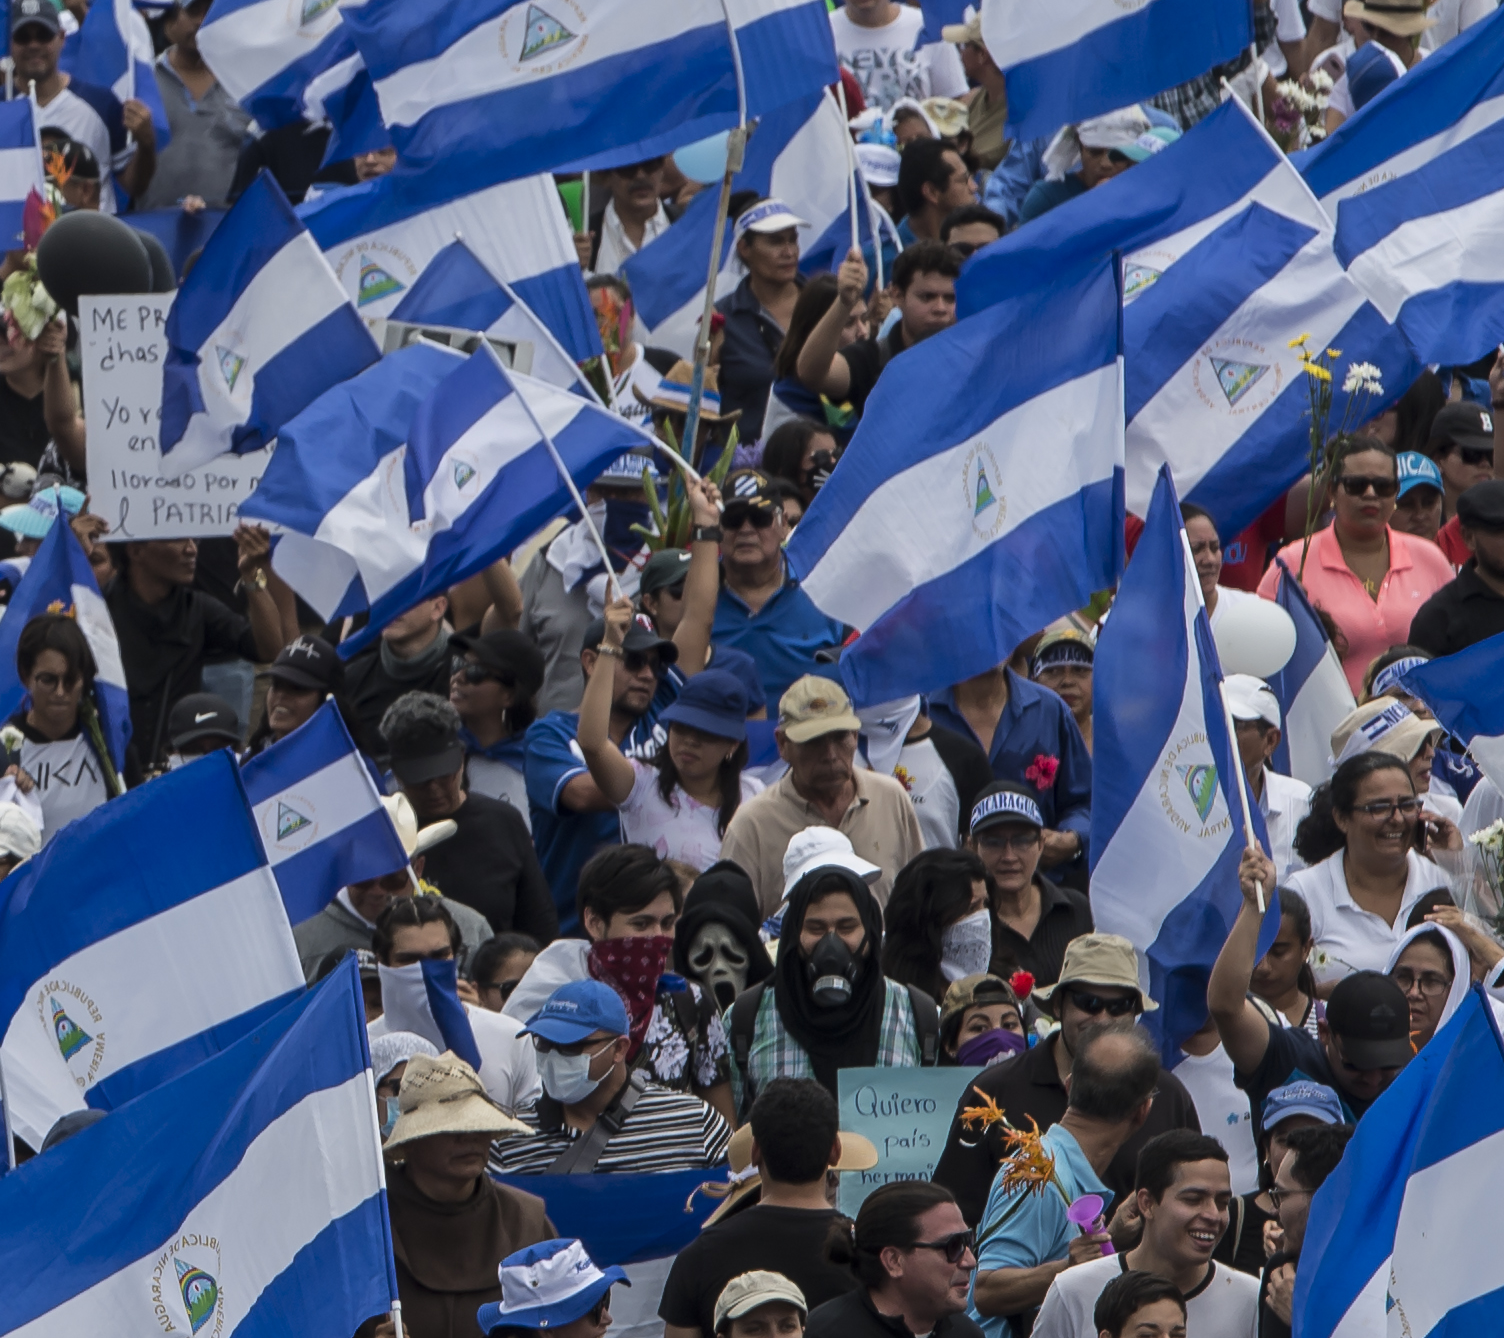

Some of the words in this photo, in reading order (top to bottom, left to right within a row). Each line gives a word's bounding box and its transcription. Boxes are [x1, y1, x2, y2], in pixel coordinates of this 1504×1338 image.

[93, 308, 127, 332] ME
[204, 474, 240, 491] por
[855, 1084, 937, 1118] Quiero
[883, 1128, 932, 1159] país
